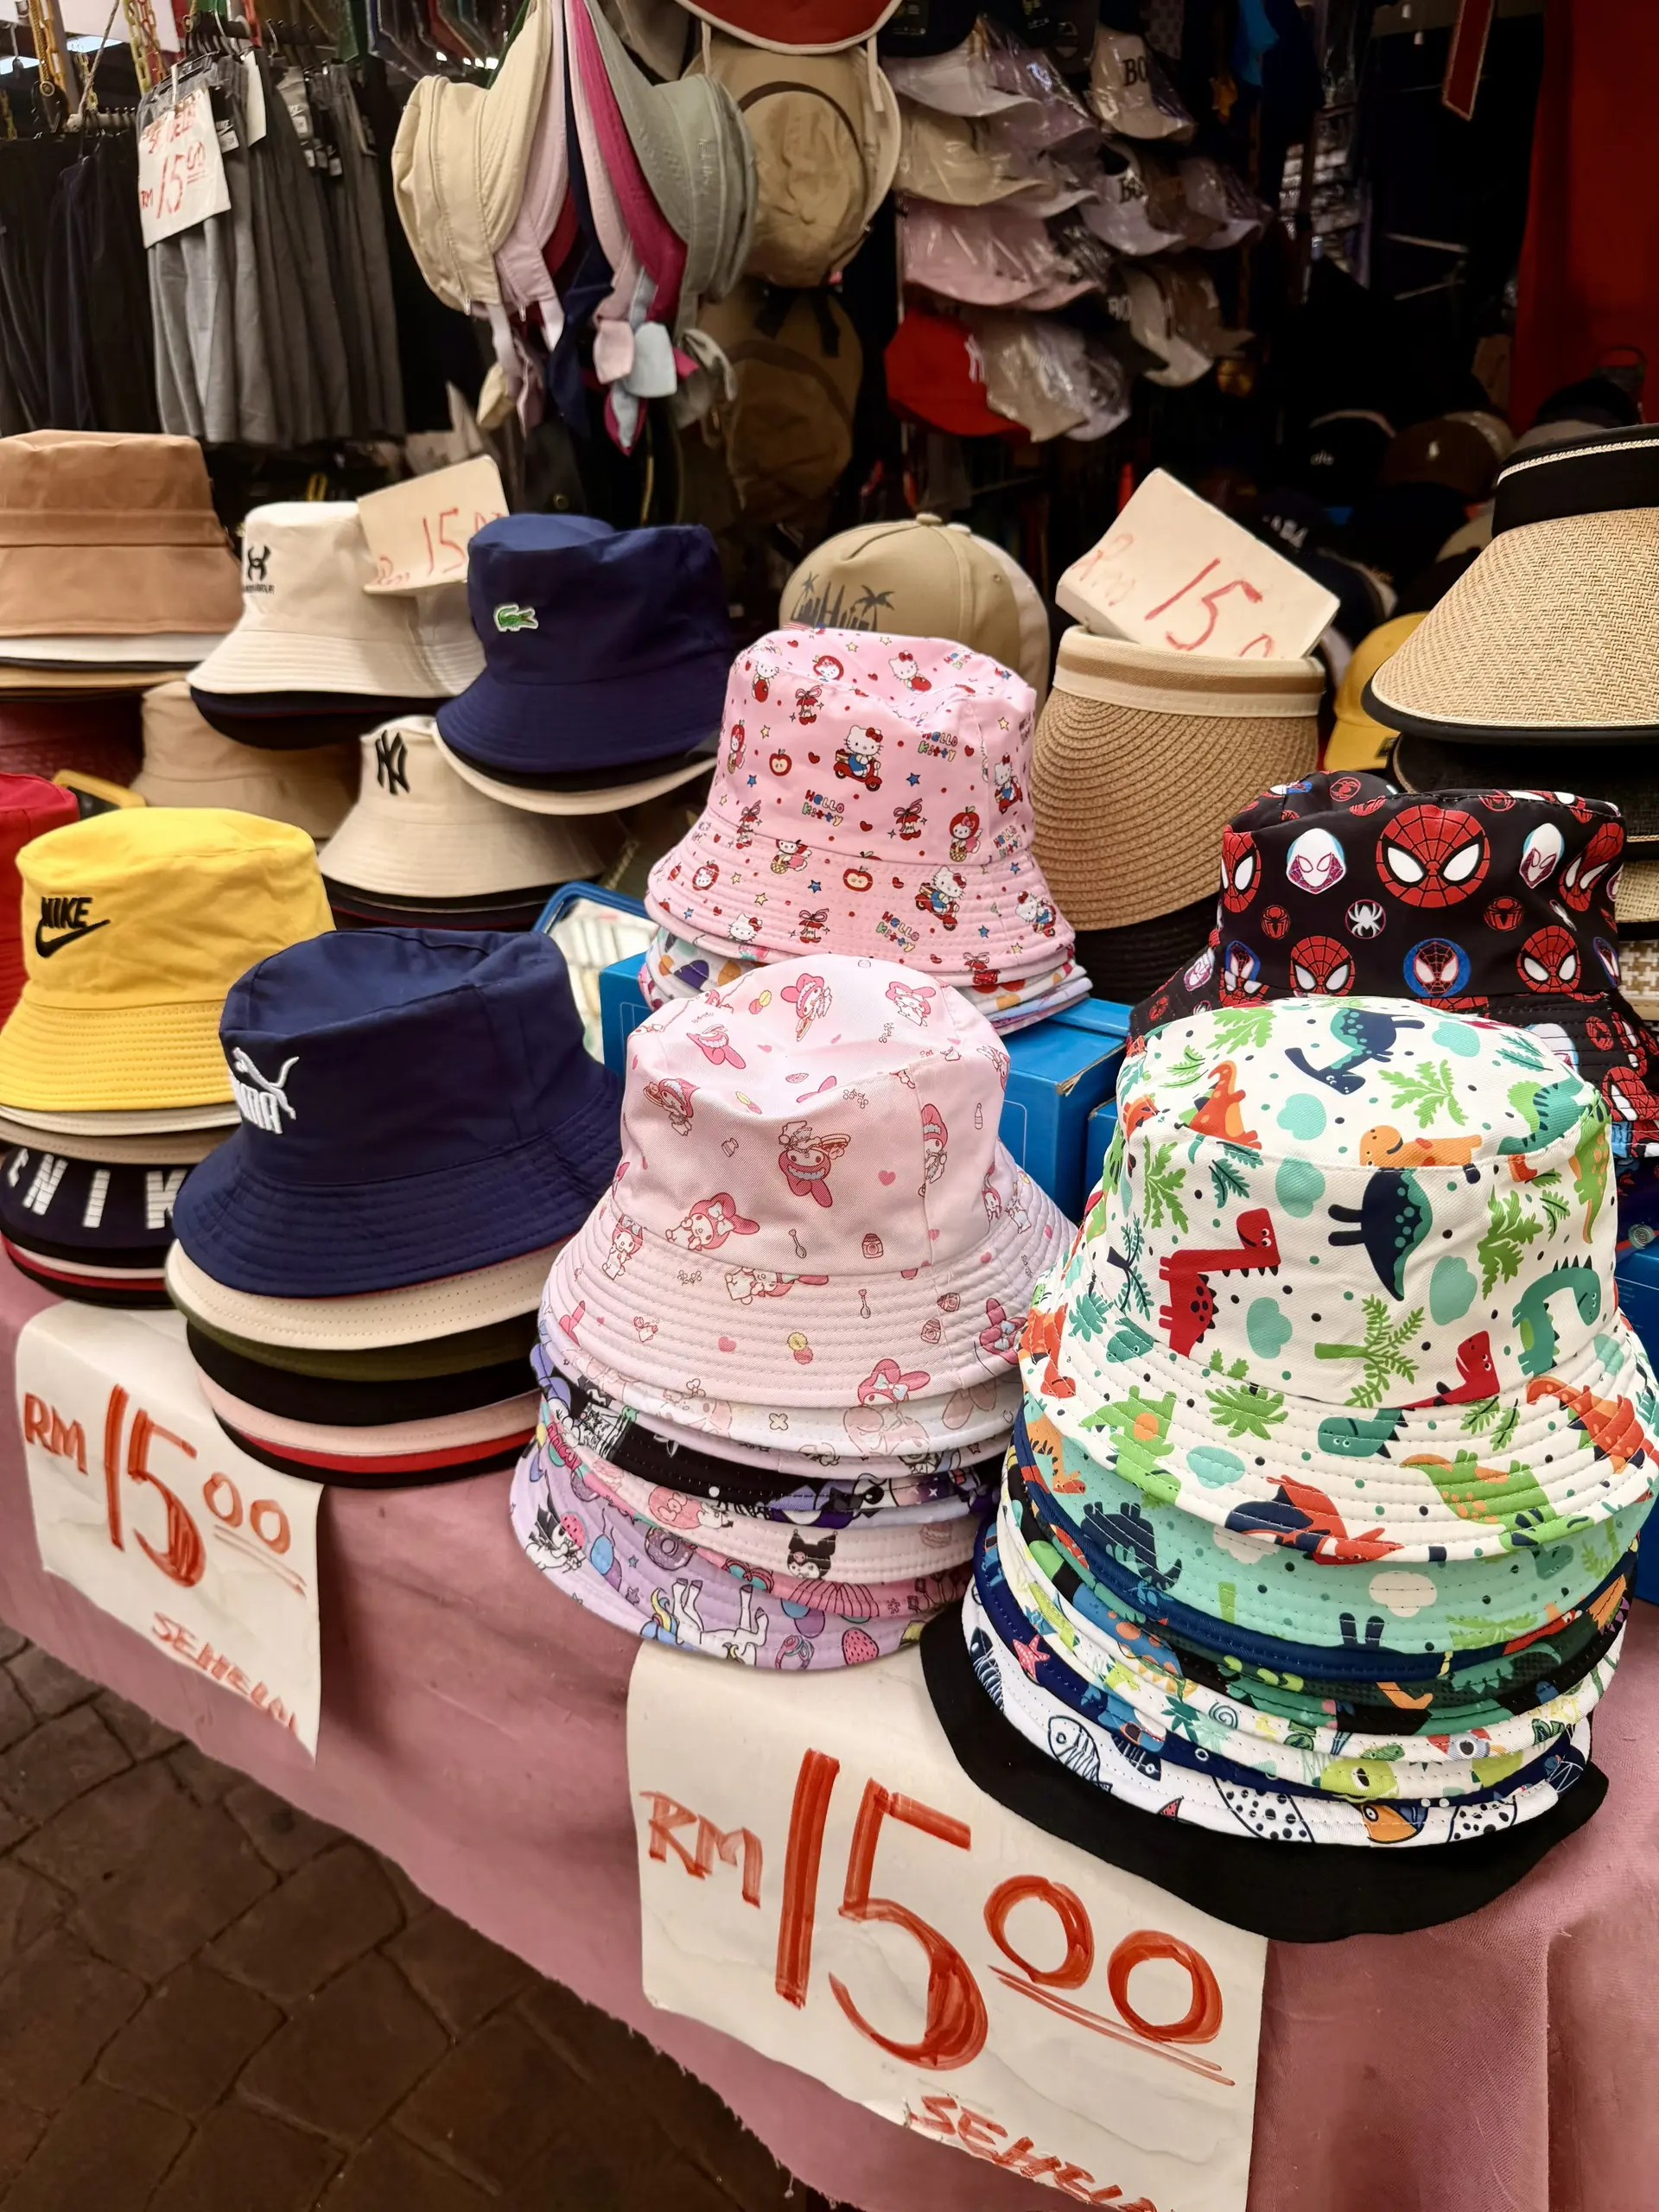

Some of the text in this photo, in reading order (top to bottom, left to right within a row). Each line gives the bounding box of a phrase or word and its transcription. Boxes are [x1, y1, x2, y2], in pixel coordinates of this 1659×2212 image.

[1144, 556, 1264, 652] 15
[41, 896, 94, 930] NIKE
[24, 1391, 88, 1477] RM
[640, 1790, 761, 1909] RM
